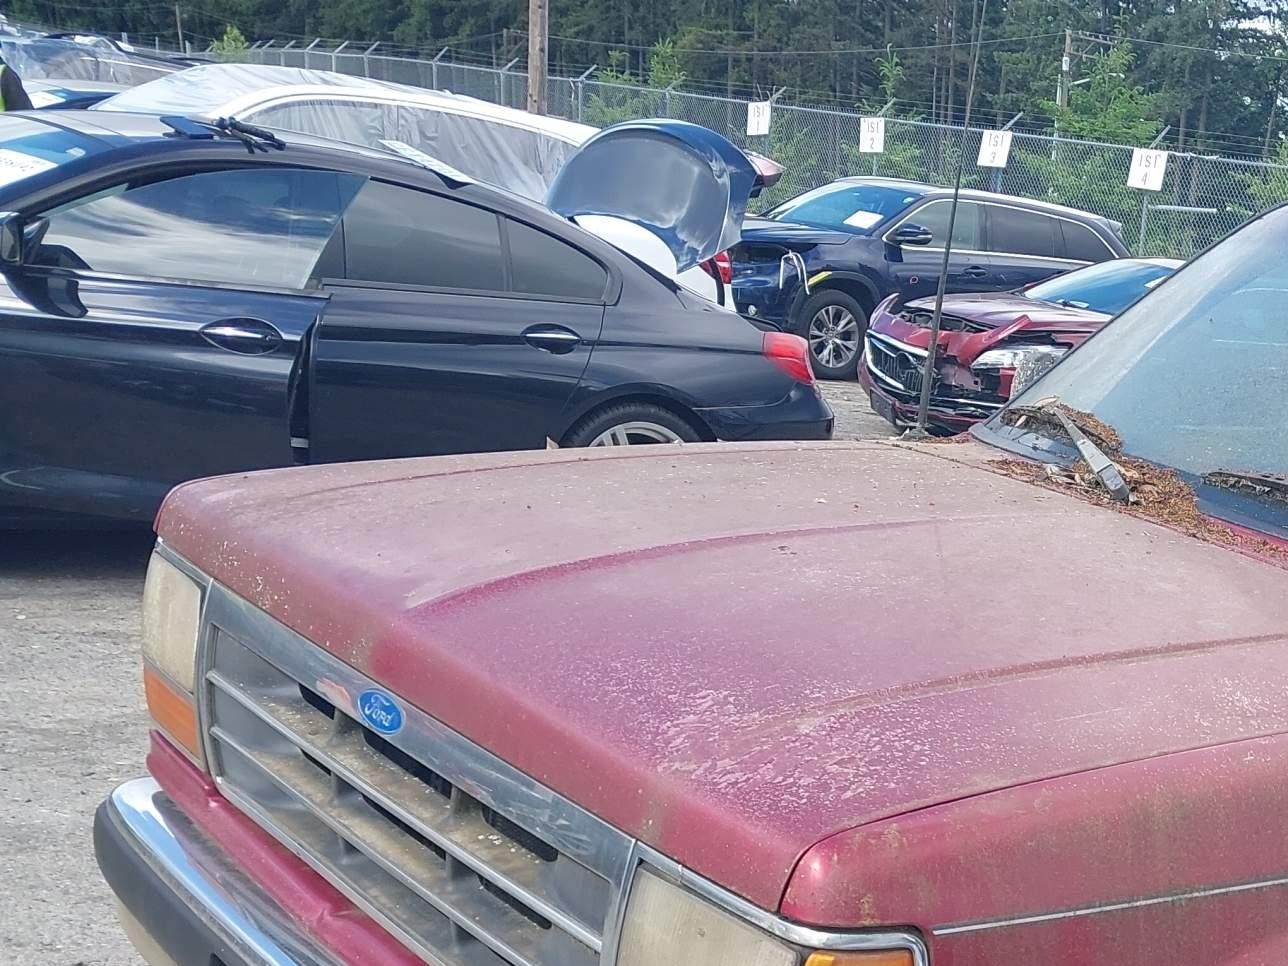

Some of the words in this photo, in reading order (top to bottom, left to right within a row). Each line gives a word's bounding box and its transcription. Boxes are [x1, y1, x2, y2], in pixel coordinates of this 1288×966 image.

[989, 151, 997, 164] 3
[1140, 171, 1149, 186] 4
[364, 694, 396, 727] Ford
